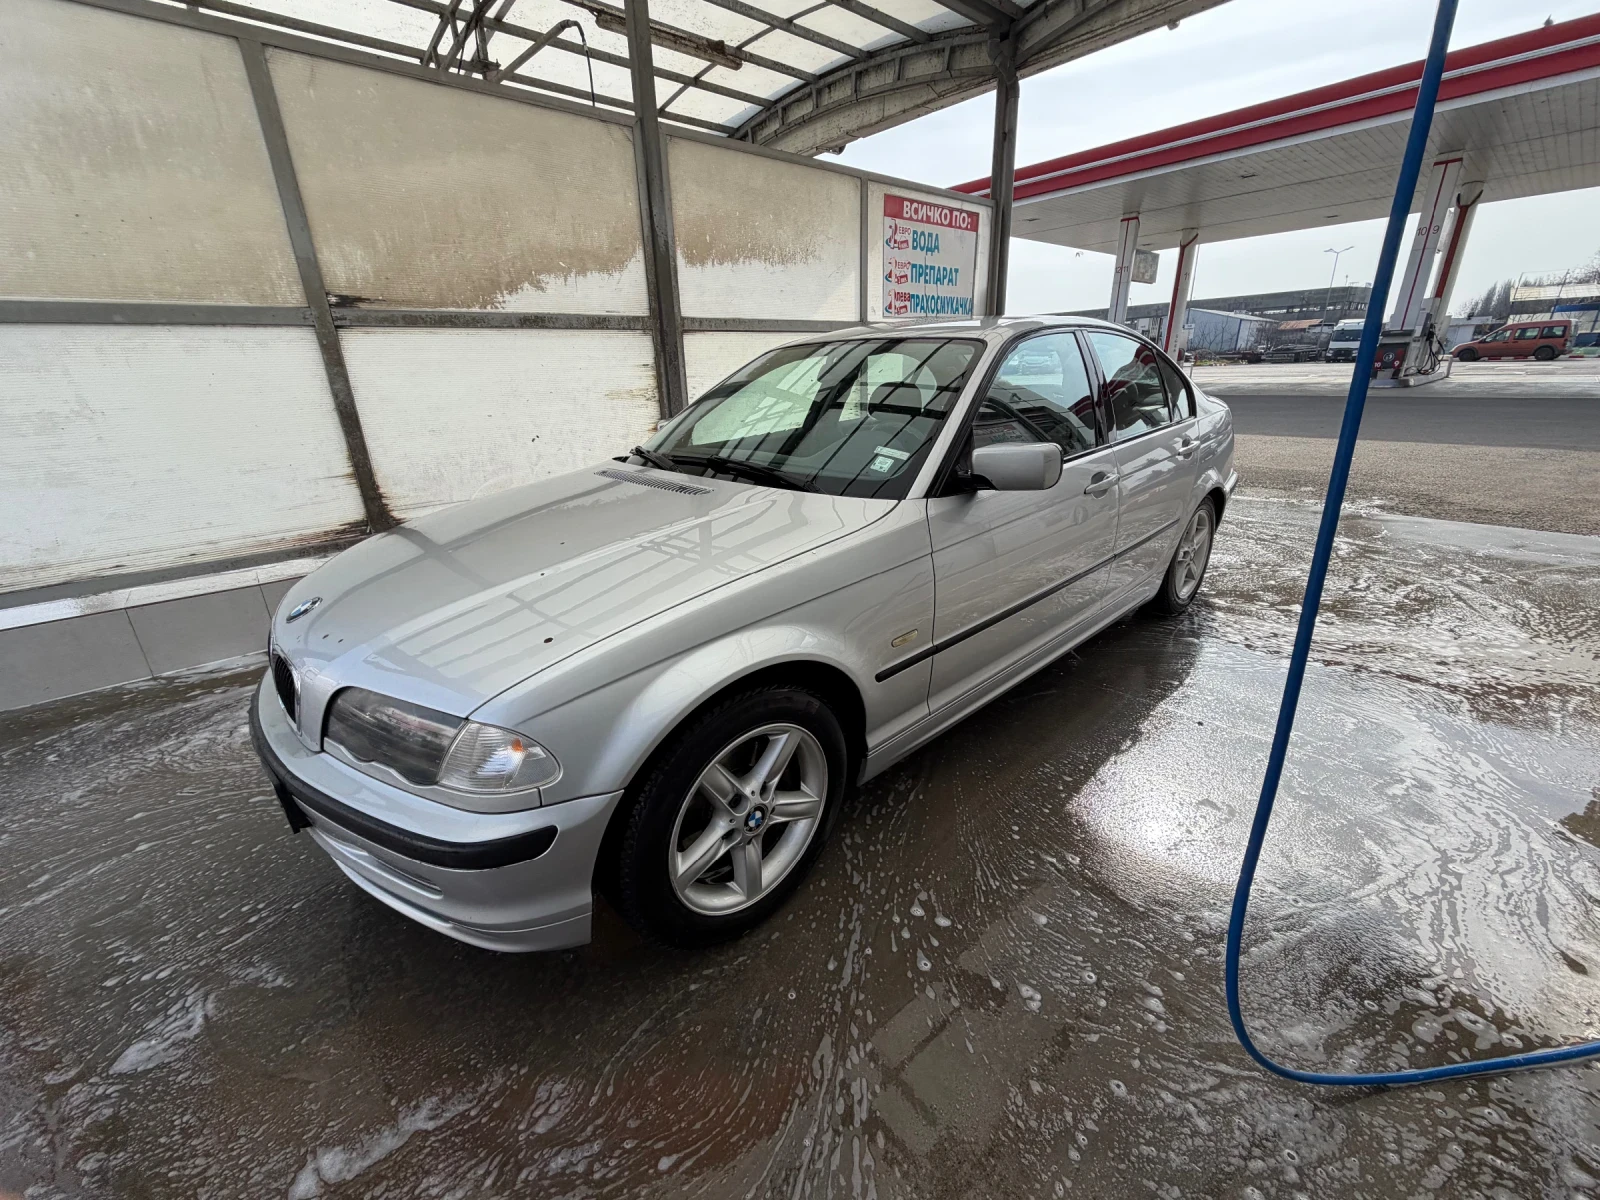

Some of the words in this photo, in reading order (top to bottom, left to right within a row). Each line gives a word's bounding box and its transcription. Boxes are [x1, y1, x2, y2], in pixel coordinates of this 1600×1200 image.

[903, 201, 950, 226] ВСИЧКО
[952, 211, 971, 229] ПО:
[898, 226, 911, 236] ЕВРО
[1417, 227, 1427, 236] 10
[1432, 225, 1440, 234] 9
[911, 229, 940, 256] ВОДА
[910, 263, 959, 286] ПРЕПАРАТ
[910, 293, 973, 316] ПРАХОСМУКАЧКА
